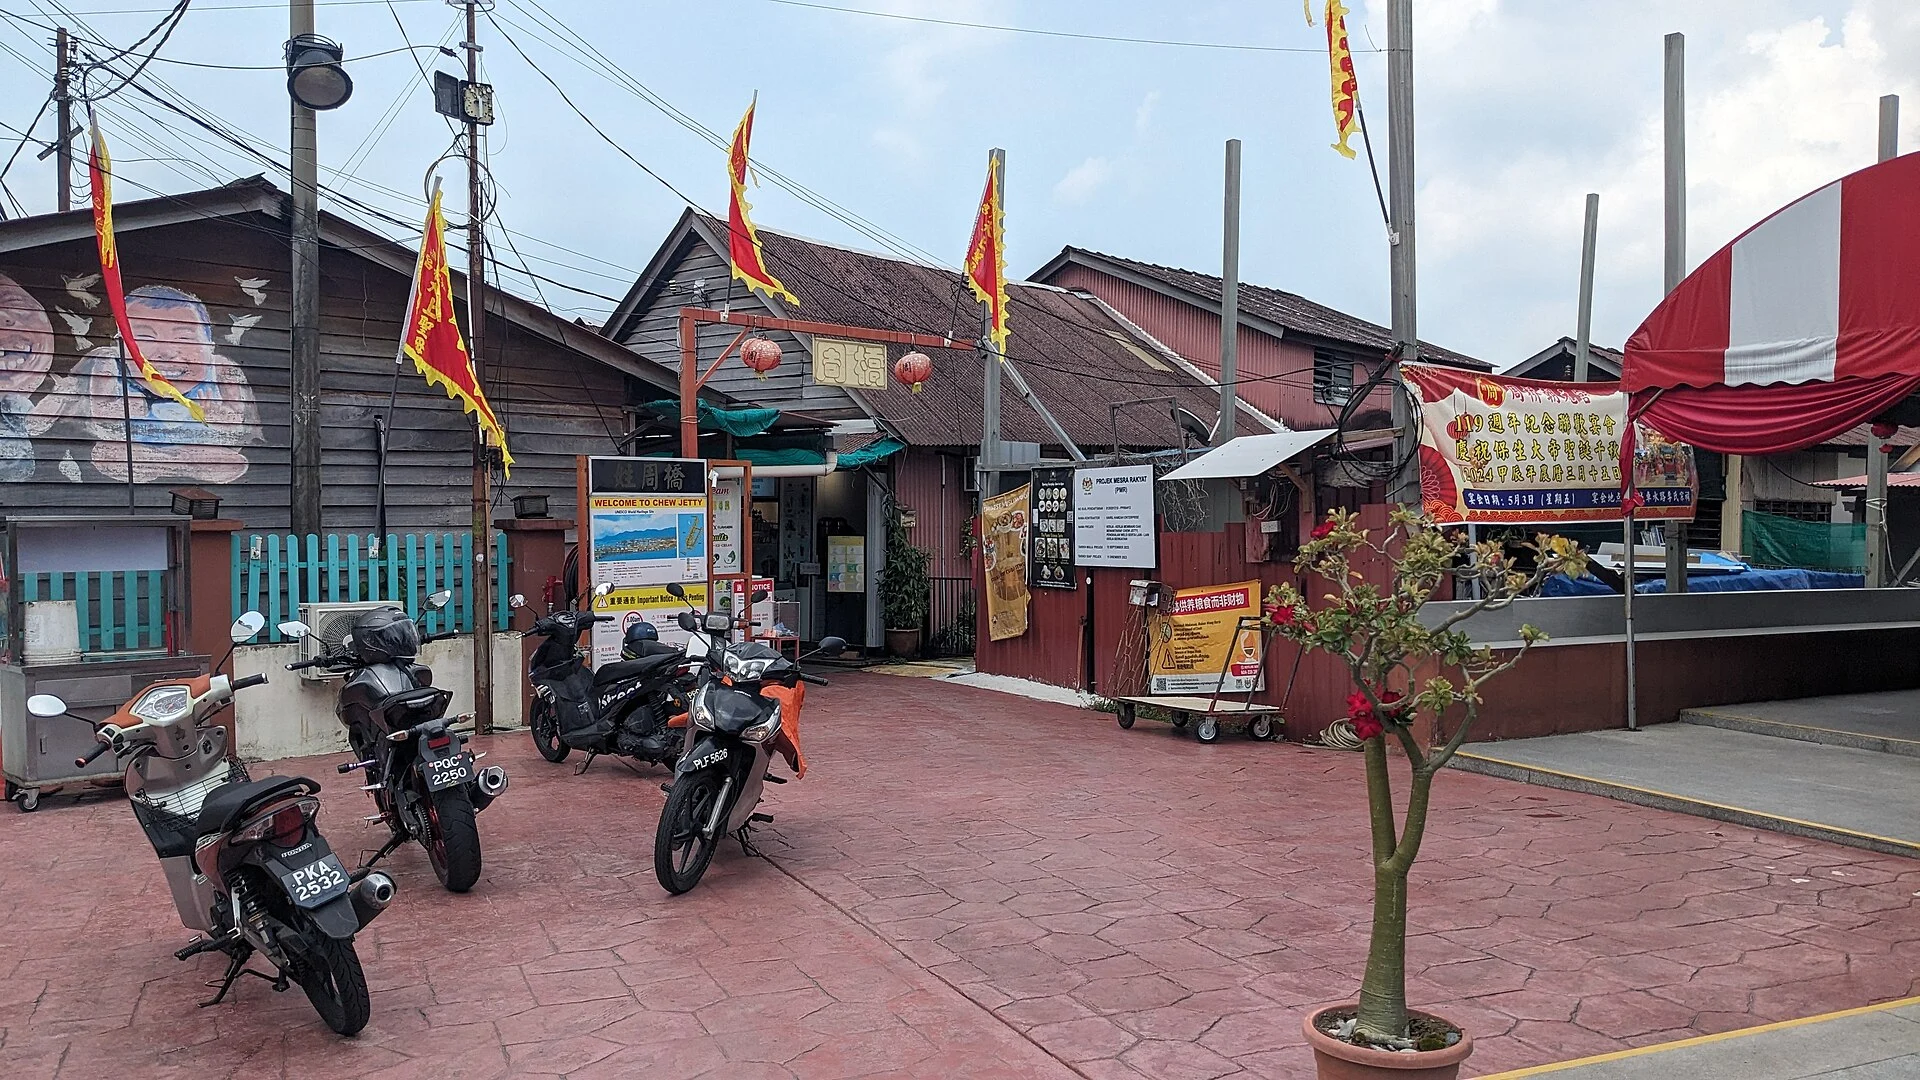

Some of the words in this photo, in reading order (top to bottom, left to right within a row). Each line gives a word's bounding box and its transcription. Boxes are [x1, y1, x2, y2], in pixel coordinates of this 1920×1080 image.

[1096, 477, 1113, 485] PROJEK
[1113, 476, 1129, 484] MESRA
[1129, 475, 1147, 483] RAKYAT
[594, 499, 637, 507] WELCOME
[639, 499, 651, 507] TO
[652, 499, 677, 507] CHEW
[678, 498, 703, 507] JETTY
[637, 595, 659, 605] Important
[660, 594, 673, 603] Notice
[688, 593, 705, 602] Penting
[434, 756, 460, 772] PQC
[693, 755, 711, 770] PLF
[710, 748, 728, 764] 5626
[432, 767, 467, 785] 2250
[281, 842, 313, 858] HONDA
[292, 860, 332, 886] PKA
[295, 870, 345, 901] 2532
